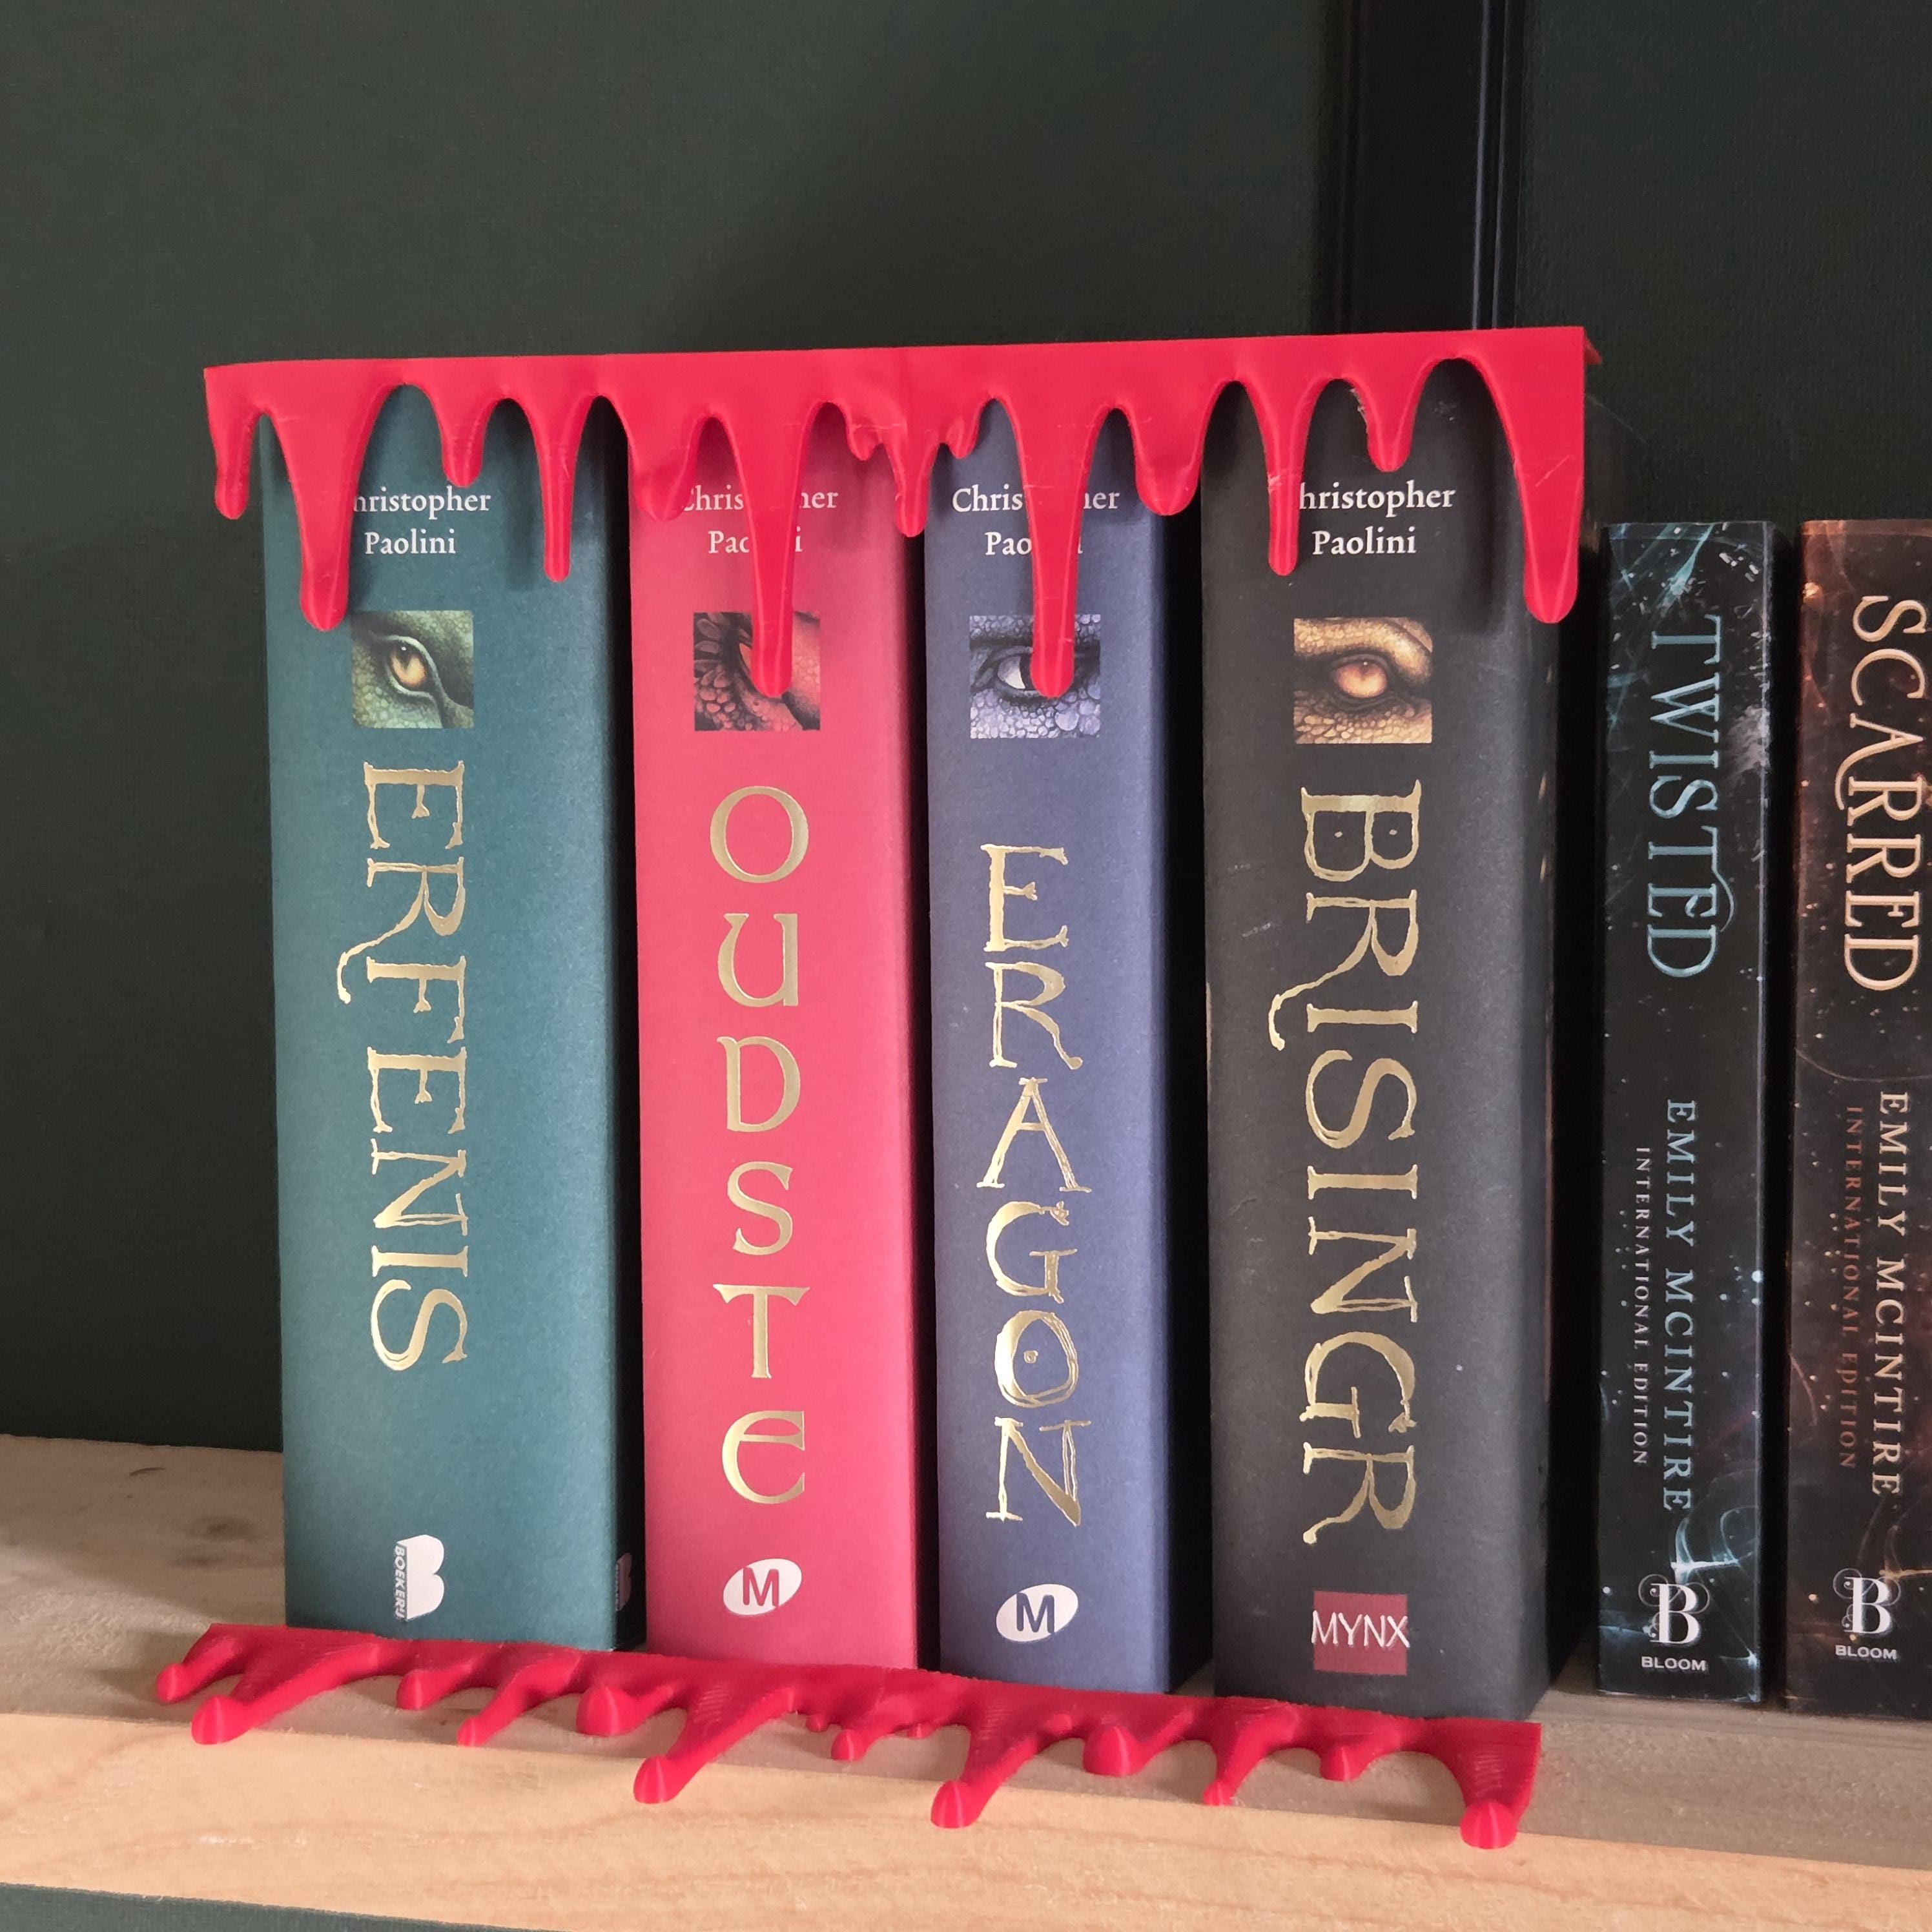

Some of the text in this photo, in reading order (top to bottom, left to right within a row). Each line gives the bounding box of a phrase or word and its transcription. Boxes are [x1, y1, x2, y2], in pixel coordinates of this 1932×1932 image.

[354, 485, 491, 520] hristopher
[952, 483, 1121, 513] Chriser
[1299, 479, 1457, 518] hristopher
[364, 528, 456, 555] Paolini
[708, 525, 803, 554] Paoi
[1311, 526, 1417, 555] Paolini
[1647, 614, 1734, 978] TWISTED
[1834, 595, 1927, 991] SCARRED
[336, 759, 468, 1372] ERFENIS
[976, 843, 1092, 1528] ERAGON
[1268, 779, 1422, 1545] BRISINGR
[1632, 1147, 1652, 1464] INTERNATIONAL EDITION
[1662, 1098, 1698, 1512] EMILY MCINTIRE
[1839, 1105, 1864, 1468] INTERNATIONAL EDITION
[1872, 1091, 1909, 1495] EMILY MCINTIRE
[1311, 1609, 1411, 1649] MYNX
[1645, 1581, 1703, 1645] B
[1839, 1574, 1896, 1636] B
[1641, 1656, 1708, 1672] BLOOM
[1834, 1644, 1898, 1660] BLOOM
